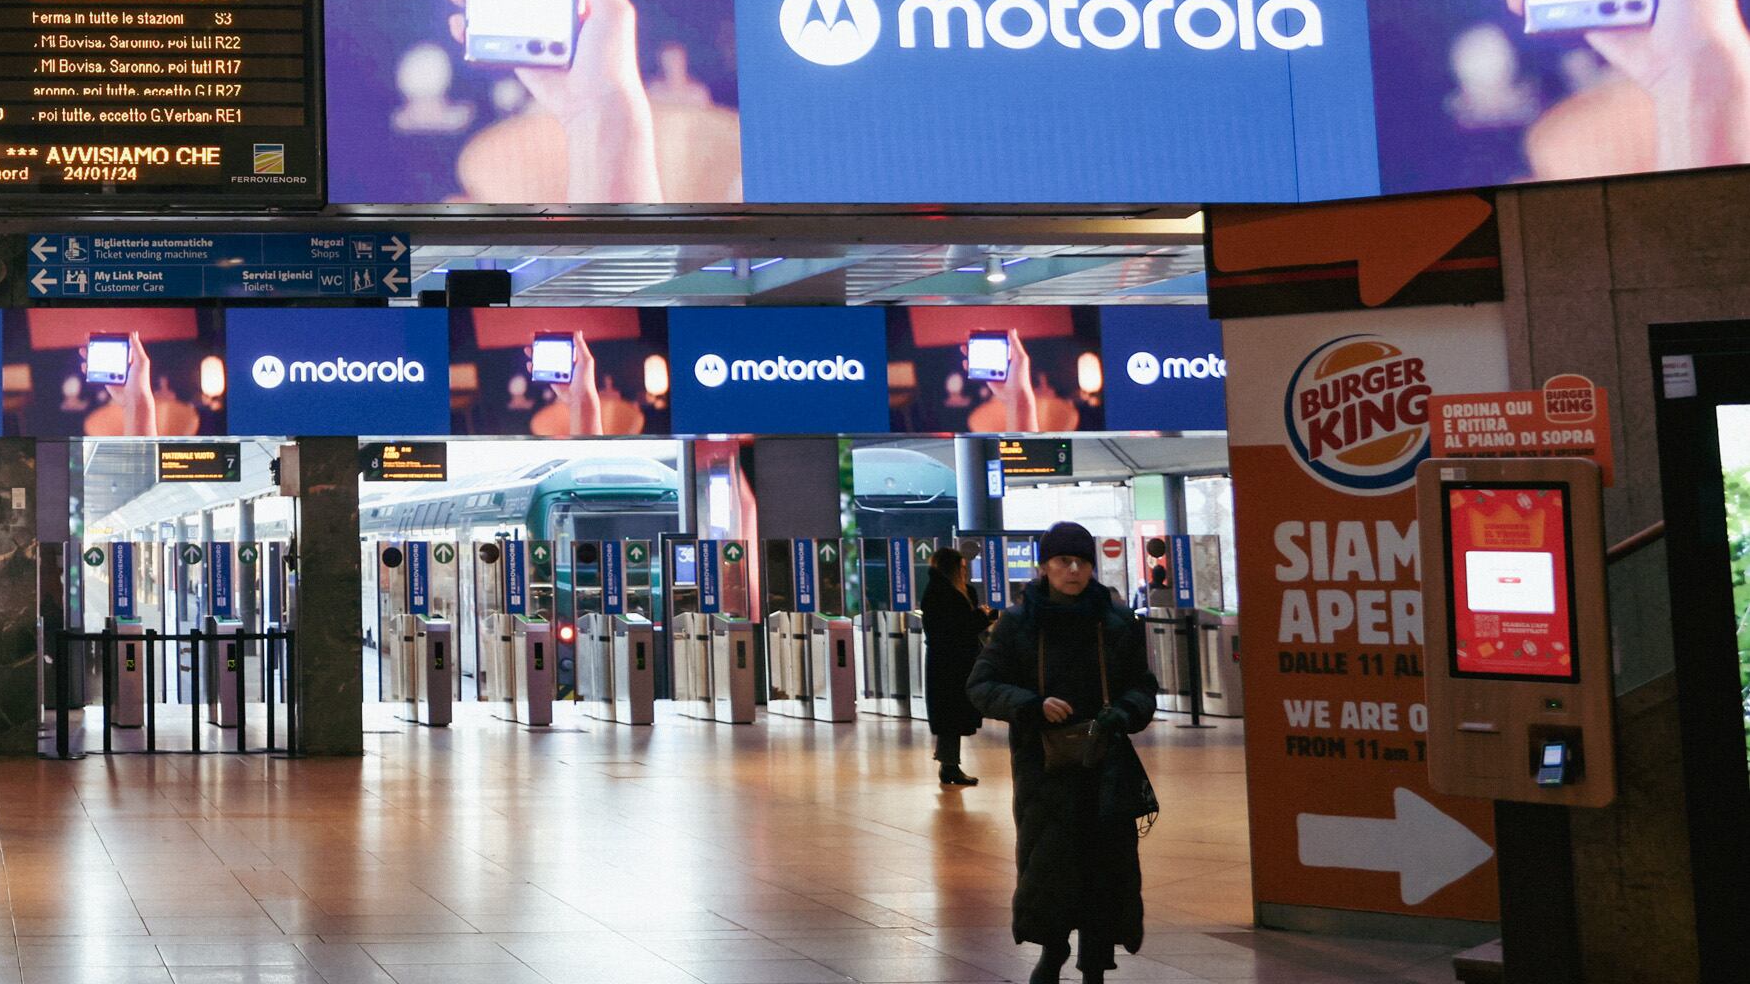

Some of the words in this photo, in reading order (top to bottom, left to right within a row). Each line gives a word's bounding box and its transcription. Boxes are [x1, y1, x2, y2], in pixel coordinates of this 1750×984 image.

[89, 11, 118, 24] tutte
[122, 12, 133, 24] le
[215, 36, 241, 49] R22
[59, 59, 106, 73] Bovisa,
[110, 59, 164, 73] Saronno,
[168, 60, 187, 73] poi
[215, 60, 241, 74] R17
[216, 84, 241, 97] R27
[38, 108, 57, 122] poi
[62, 108, 95, 122] tutte,
[99, 108, 147, 122] eccetto
[216, 109, 241, 122] RE1
[46, 147, 169, 165] AVVISIAMO
[175, 147, 221, 165] CHE
[63, 167, 137, 181] 24/01/24
[231, 176, 307, 184] FERROVIENORD
[94, 237, 149, 250] Biglietterie
[151, 237, 213, 248] automatiche
[311, 237, 344, 249] Negozi
[94, 249, 123, 259] Ticket
[126, 249, 162, 261] vending
[164, 249, 208, 259] machines
[311, 249, 340, 260] Shops
[242, 270, 275, 281] Servizi
[278, 269, 313, 282] igienici
[320, 275, 343, 287] WC
[242, 282, 274, 292] Toilets
[289, 356, 425, 383] motorola
[730, 354, 865, 381] motorola
[1300, 357, 1426, 421] BURGER
[1546, 389, 1592, 400] BURGER
[1442, 402, 1500, 418] ORDINA
[1505, 401, 1533, 415] QUI
[1547, 399, 1593, 413] KING
[1308, 384, 1432, 460] KING
[1444, 419, 1453, 433] E
[1458, 418, 1508, 433] RITIRA
[1445, 434, 1463, 448] AL
[1468, 432, 1515, 447] PIANO
[1521, 431, 1537, 445] DI
[1541, 429, 1595, 444] SOPRA
[226, 458, 234, 469] 7
[1058, 452, 1066, 463] 9
[1278, 651, 1348, 675] DALLE
[1358, 653, 1384, 676] 11
[1283, 699, 1331, 729] WE
[1340, 701, 1399, 732] ARE
[1286, 735, 1346, 760] FROM
